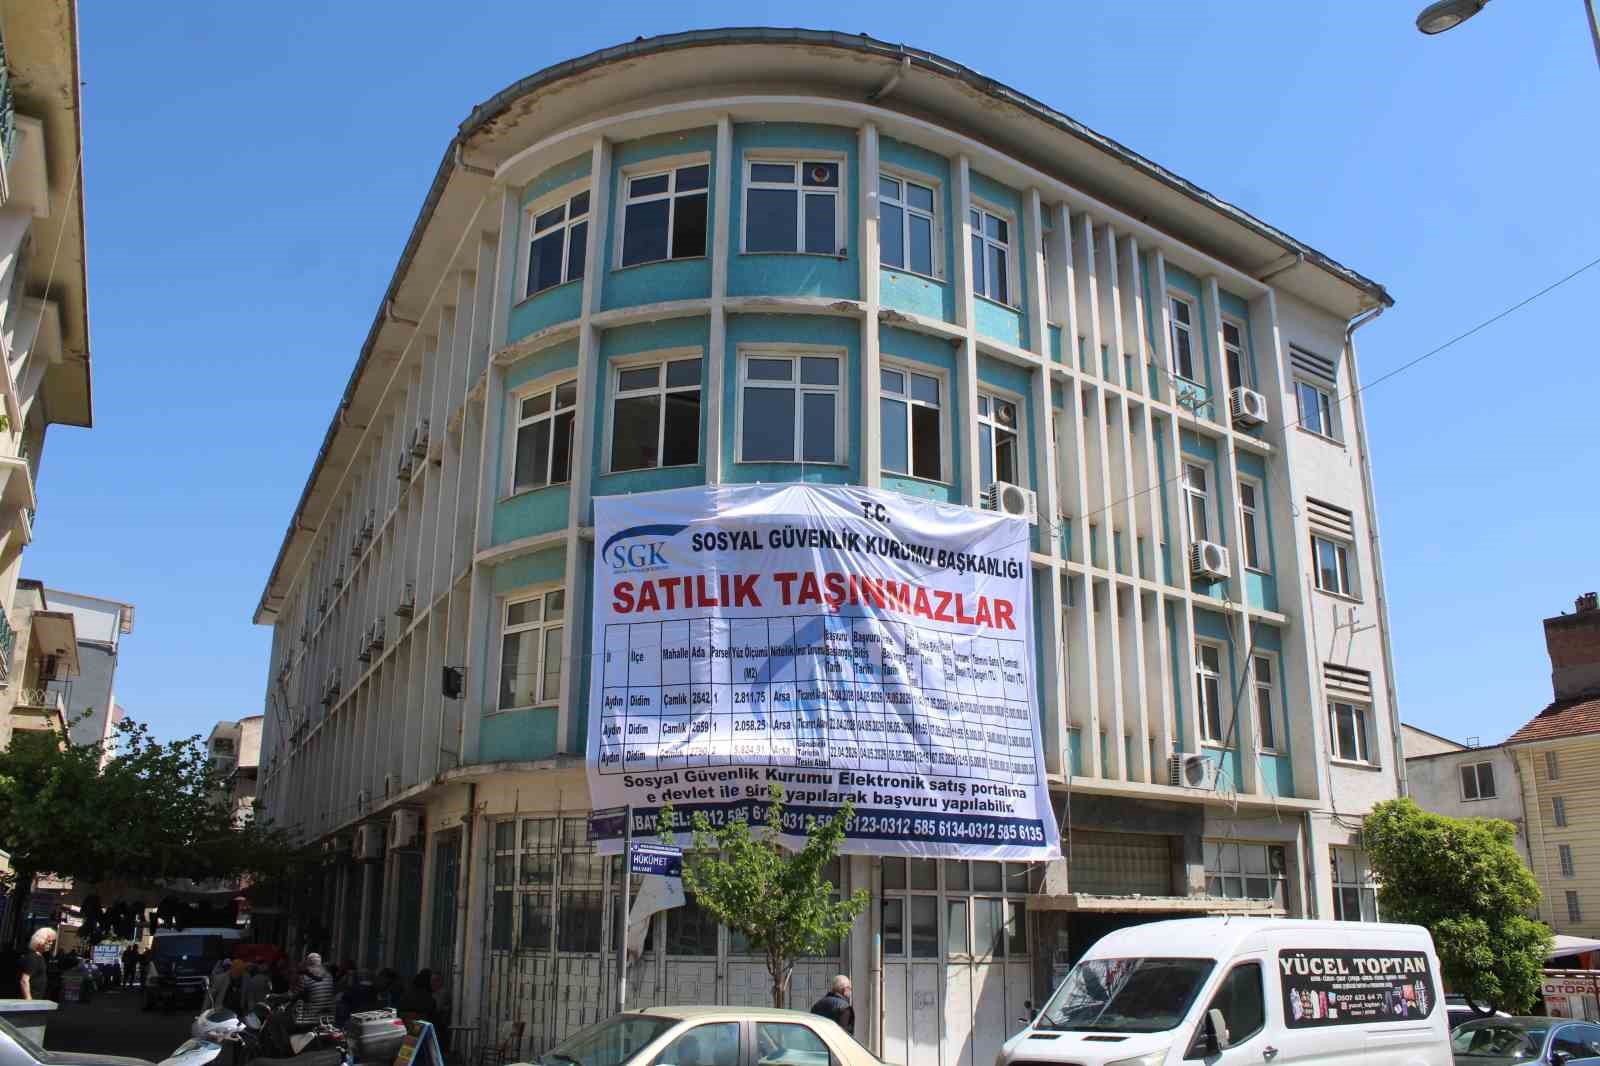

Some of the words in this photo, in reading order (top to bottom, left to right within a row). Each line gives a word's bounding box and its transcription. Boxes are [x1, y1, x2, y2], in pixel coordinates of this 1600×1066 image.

[861, 501, 891, 524] T.C.
[613, 541, 671, 568] SGK
[692, 529, 763, 552] SOSYAL
[768, 525, 861, 552] GÜVENLİK
[866, 535, 933, 565] KURUMU
[937, 551, 1024, 579] BAŞKANLIĞI
[612, 573, 762, 614] SATILIK
[773, 571, 1017, 631] TAŞINMAZLAR
[663, 647, 689, 659] Mahalle
[692, 646, 706, 657] Ada
[605, 696, 623, 709] Aydın
[630, 695, 650, 706] Didim
[664, 693, 687, 708] Çamlık
[774, 691, 791, 702] Arsa
[603, 724, 621, 738] Aydın
[628, 723, 649, 735] Didim
[662, 722, 687, 736] Çamlık
[773, 719, 791, 730] Arsa
[601, 751, 619, 766] Aydın
[626, 750, 646, 762] Didim
[624, 772, 679, 791] Sosyal
[684, 767, 758, 783] Güvenlik
[765, 768, 832, 786] Kurumu
[839, 771, 925, 790] Elektronik
[930, 781, 967, 795] satış
[971, 783, 1027, 801] portalına
[646, 793, 656, 803] e
[662, 786, 714, 802] devlet
[719, 783, 738, 798] ile
[786, 787, 867, 806] yapılarak
[873, 791, 937, 809] başvuru
[941, 799, 1015, 814] yapılabilir.
[914, 819, 935, 836] 585
[939, 821, 994, 839] 6134-0312
[997, 823, 1016, 840] 585
[1019, 825, 1043, 841] 6135
[633, 854, 667, 866] HÜKÜMET
[1279, 953, 1349, 975] YÜCEL
[1352, 957, 1426, 974] TOPTAN
